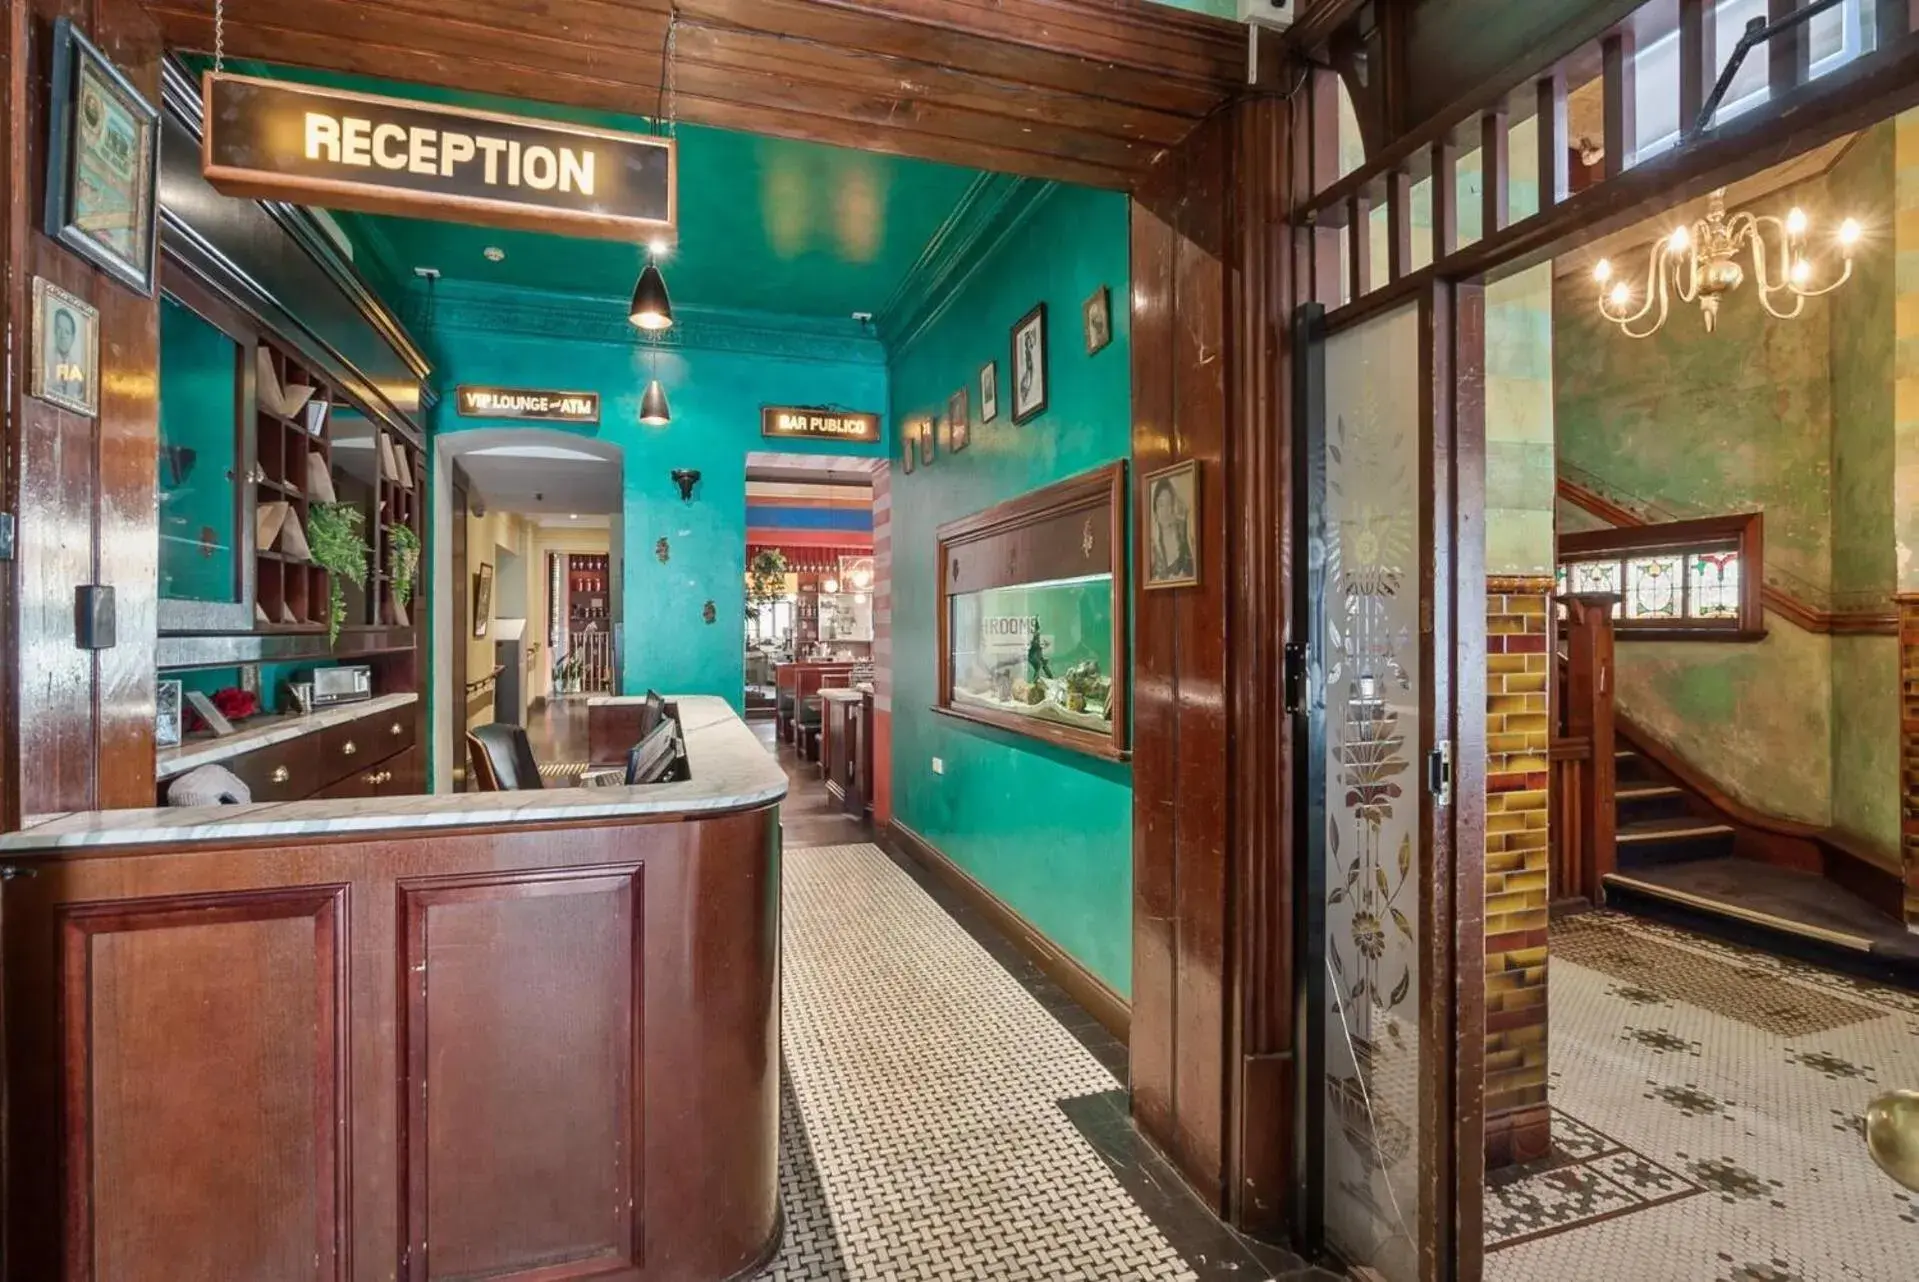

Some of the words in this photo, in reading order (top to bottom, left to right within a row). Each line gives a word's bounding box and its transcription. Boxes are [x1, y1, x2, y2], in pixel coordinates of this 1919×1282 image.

[304, 112, 595, 195] RECEPTION
[466, 392, 491, 409] VIP
[493, 395, 548, 412] LOUNGE
[561, 399, 591, 414] ATM
[779, 415, 807, 430] BAR
[810, 417, 866, 434] PUBLICO
